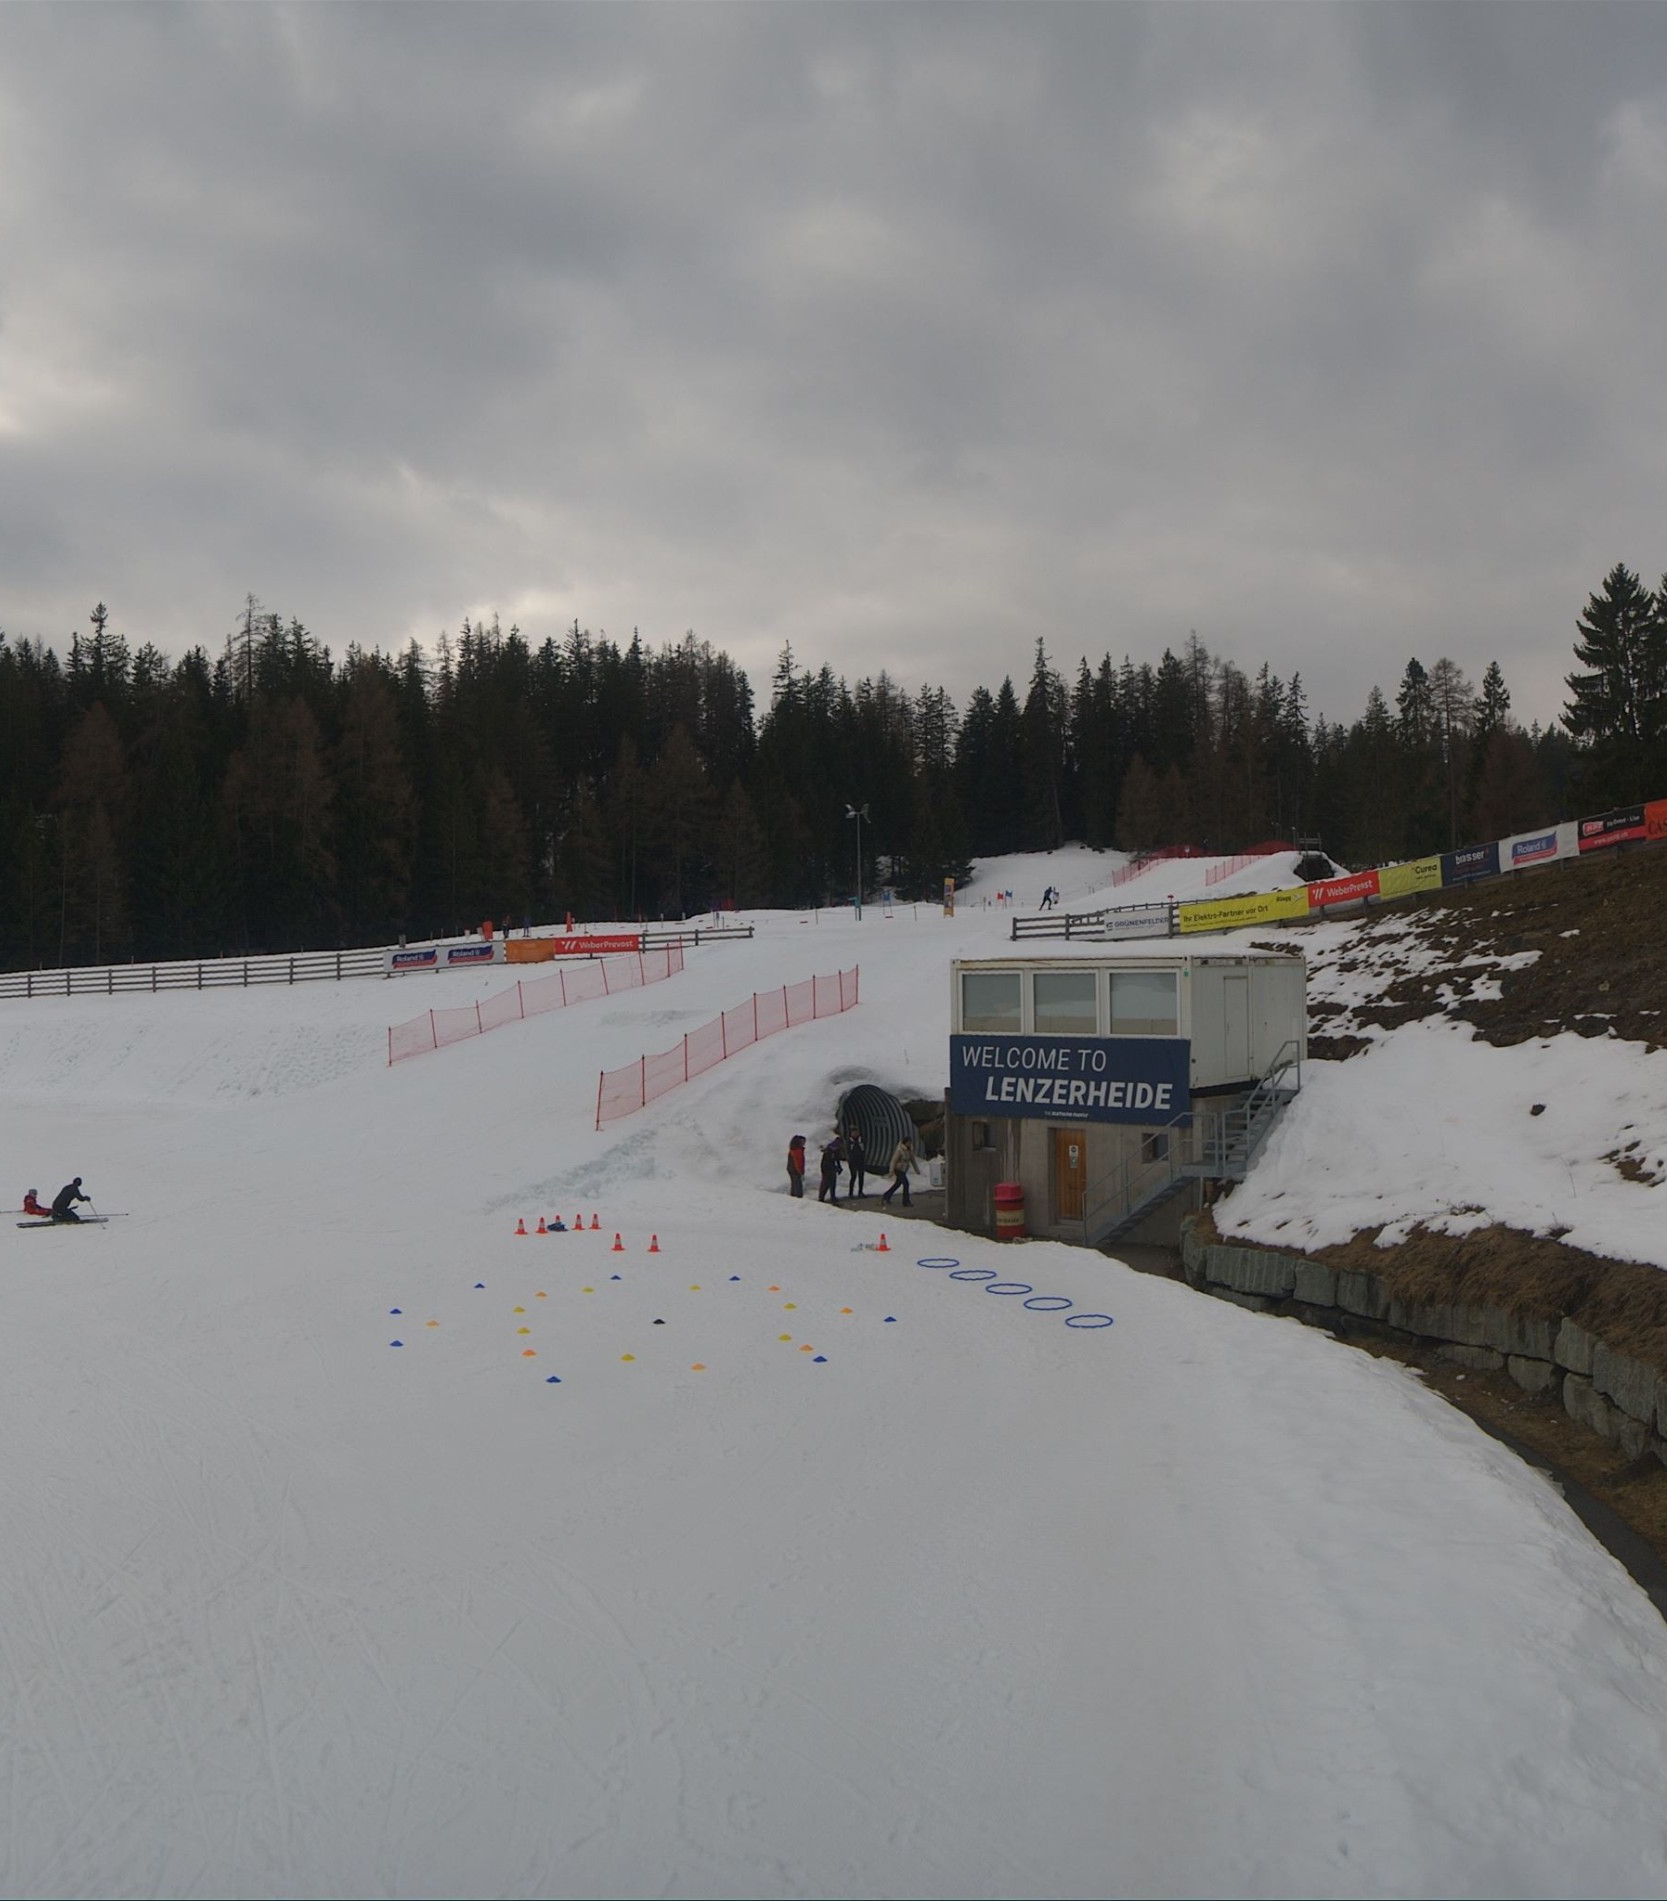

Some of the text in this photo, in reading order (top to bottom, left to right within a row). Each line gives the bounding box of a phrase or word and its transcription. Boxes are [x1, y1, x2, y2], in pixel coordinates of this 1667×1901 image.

[1516, 842, 1541, 855] Roland
[962, 1045, 1107, 1073] WELCOME TO
[985, 1076, 1173, 1110] LENZERHEIDE
